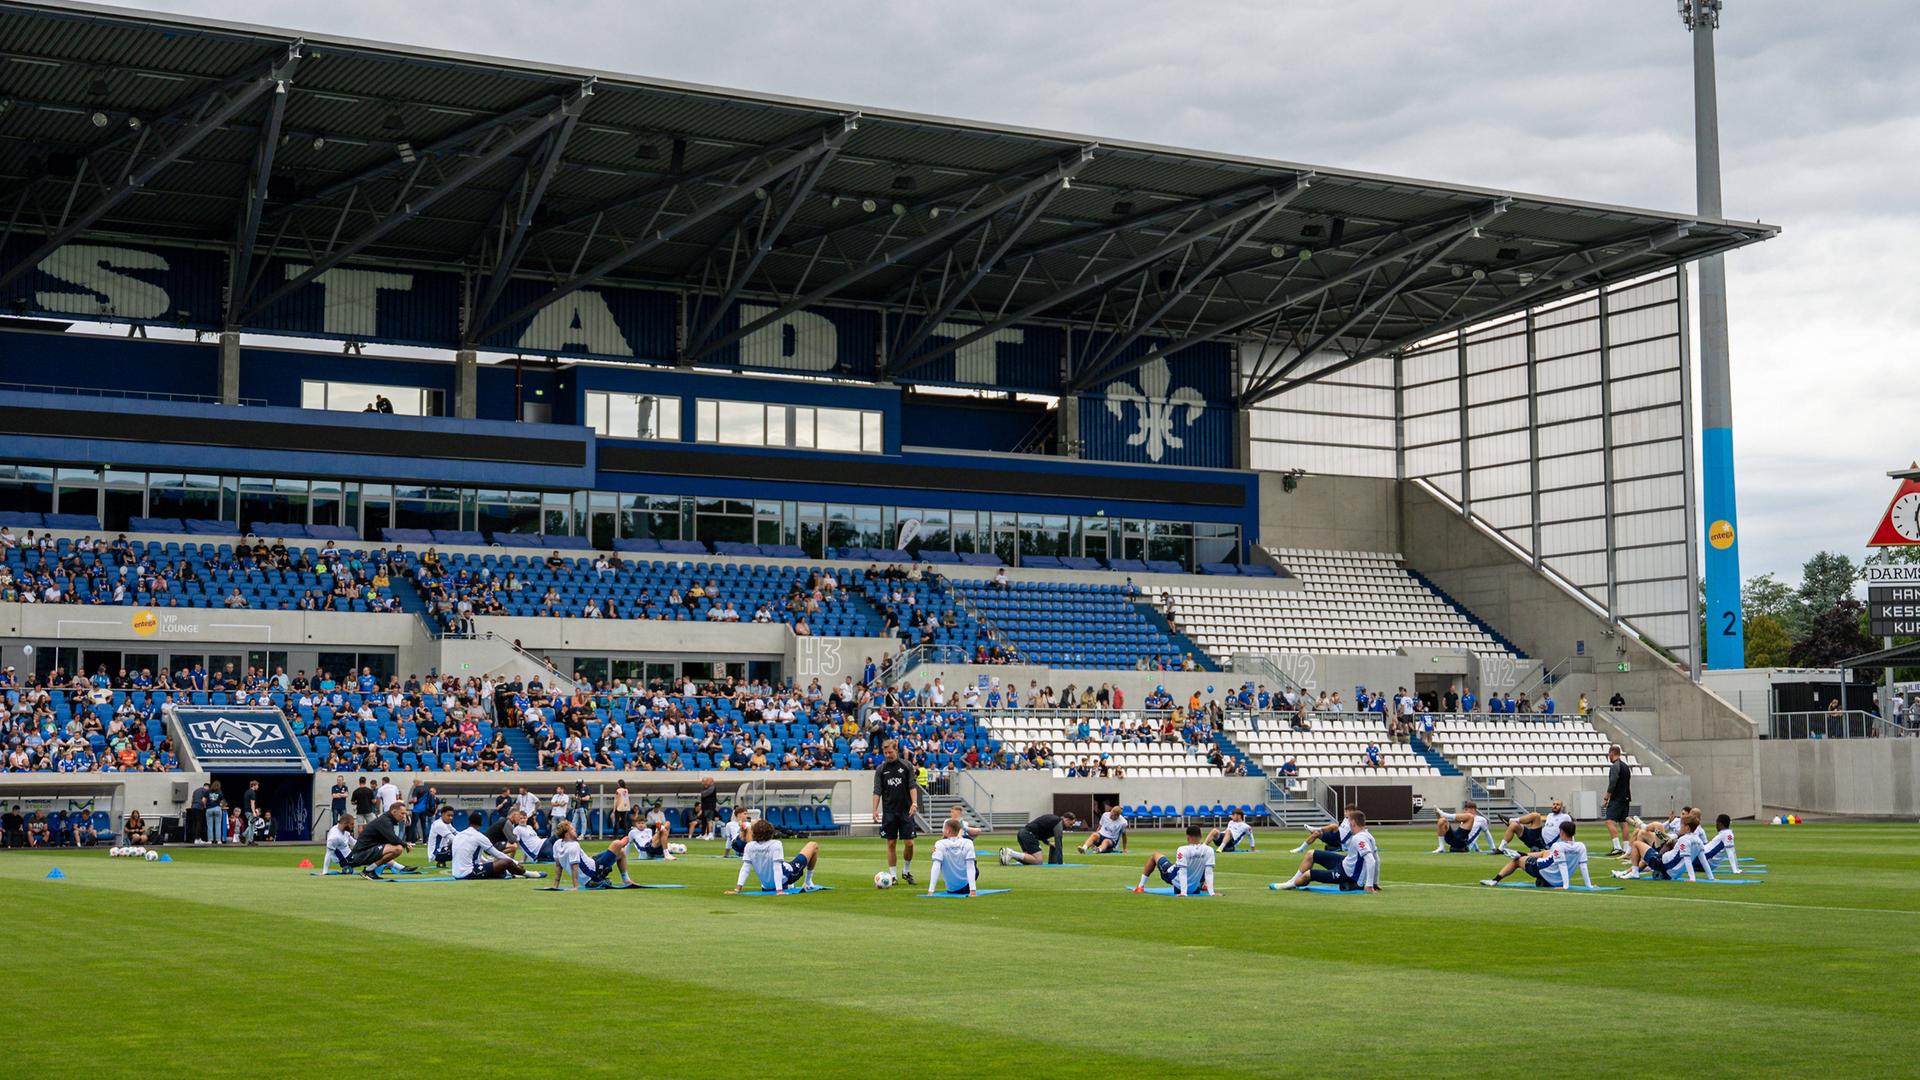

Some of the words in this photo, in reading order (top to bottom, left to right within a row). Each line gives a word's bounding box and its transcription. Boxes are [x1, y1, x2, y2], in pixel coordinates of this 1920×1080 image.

[1870, 567, 1920, 580] DARM
[163, 615, 178, 623] VIP
[163, 624, 199, 633] LOUNGE
[1722, 611, 1737, 636] 2
[799, 636, 842, 676] H3
[1481, 658, 1515, 687] W2
